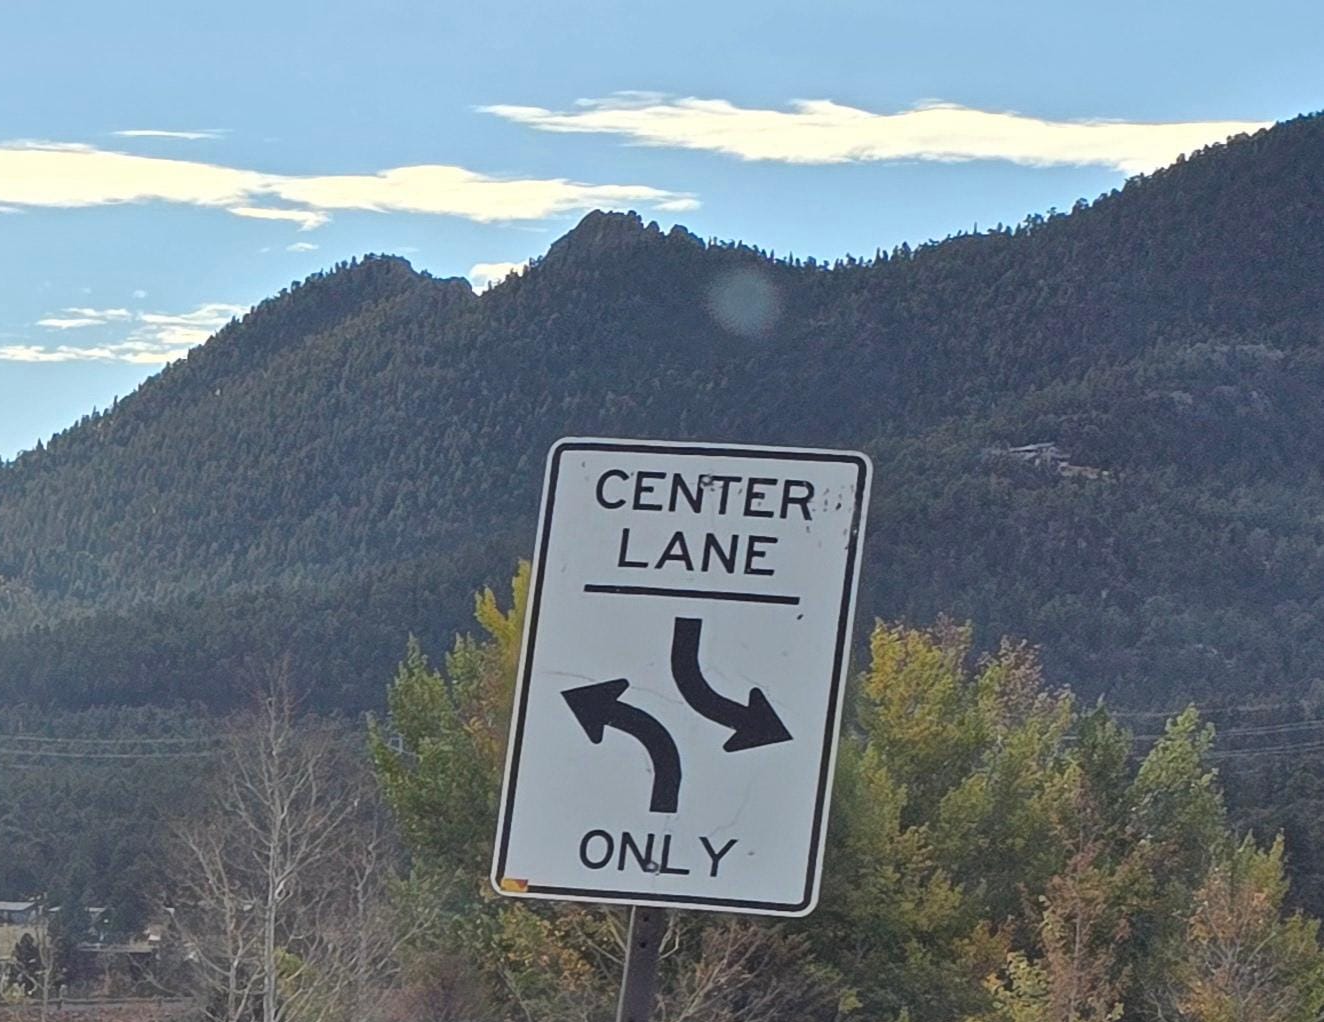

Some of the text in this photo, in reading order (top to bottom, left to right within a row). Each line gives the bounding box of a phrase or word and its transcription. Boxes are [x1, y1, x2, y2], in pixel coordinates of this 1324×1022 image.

[595, 468, 815, 521] CENTER
[617, 527, 778, 577] LANE
[579, 829, 739, 877] ONLY
